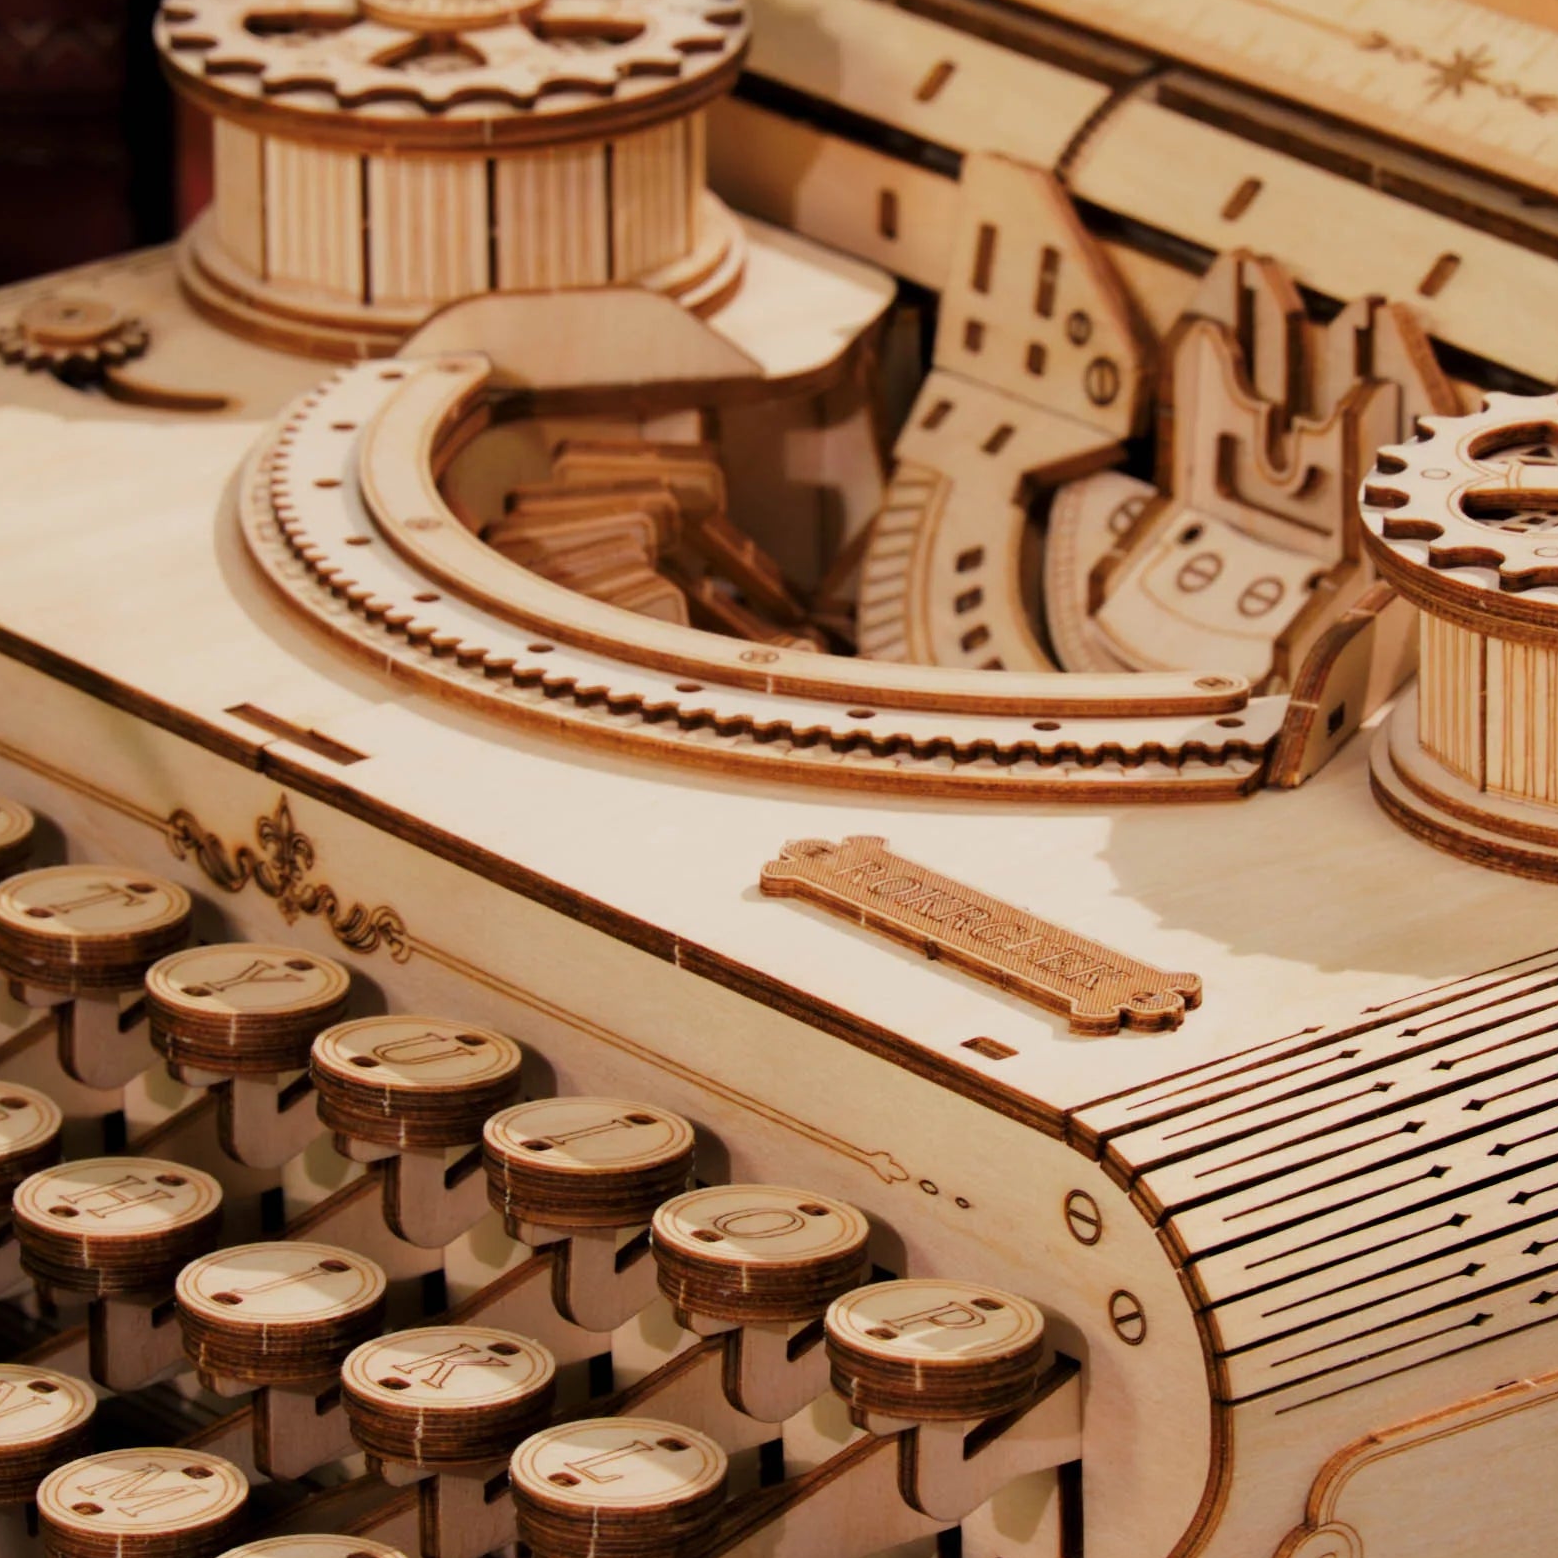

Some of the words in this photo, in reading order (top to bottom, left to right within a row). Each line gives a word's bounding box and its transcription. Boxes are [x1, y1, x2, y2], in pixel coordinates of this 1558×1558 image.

[50, 882, 146, 915] T
[201, 959, 305, 992] Y
[373, 1032, 477, 1066] U
[547, 1119, 633, 1145] I
[58, 1175, 175, 1219] H
[711, 1205, 806, 1239] O
[893, 1300, 986, 1331] P
[392, 1343, 511, 1389] K
[563, 1440, 653, 1485] L
[75, 1461, 211, 1518] M
